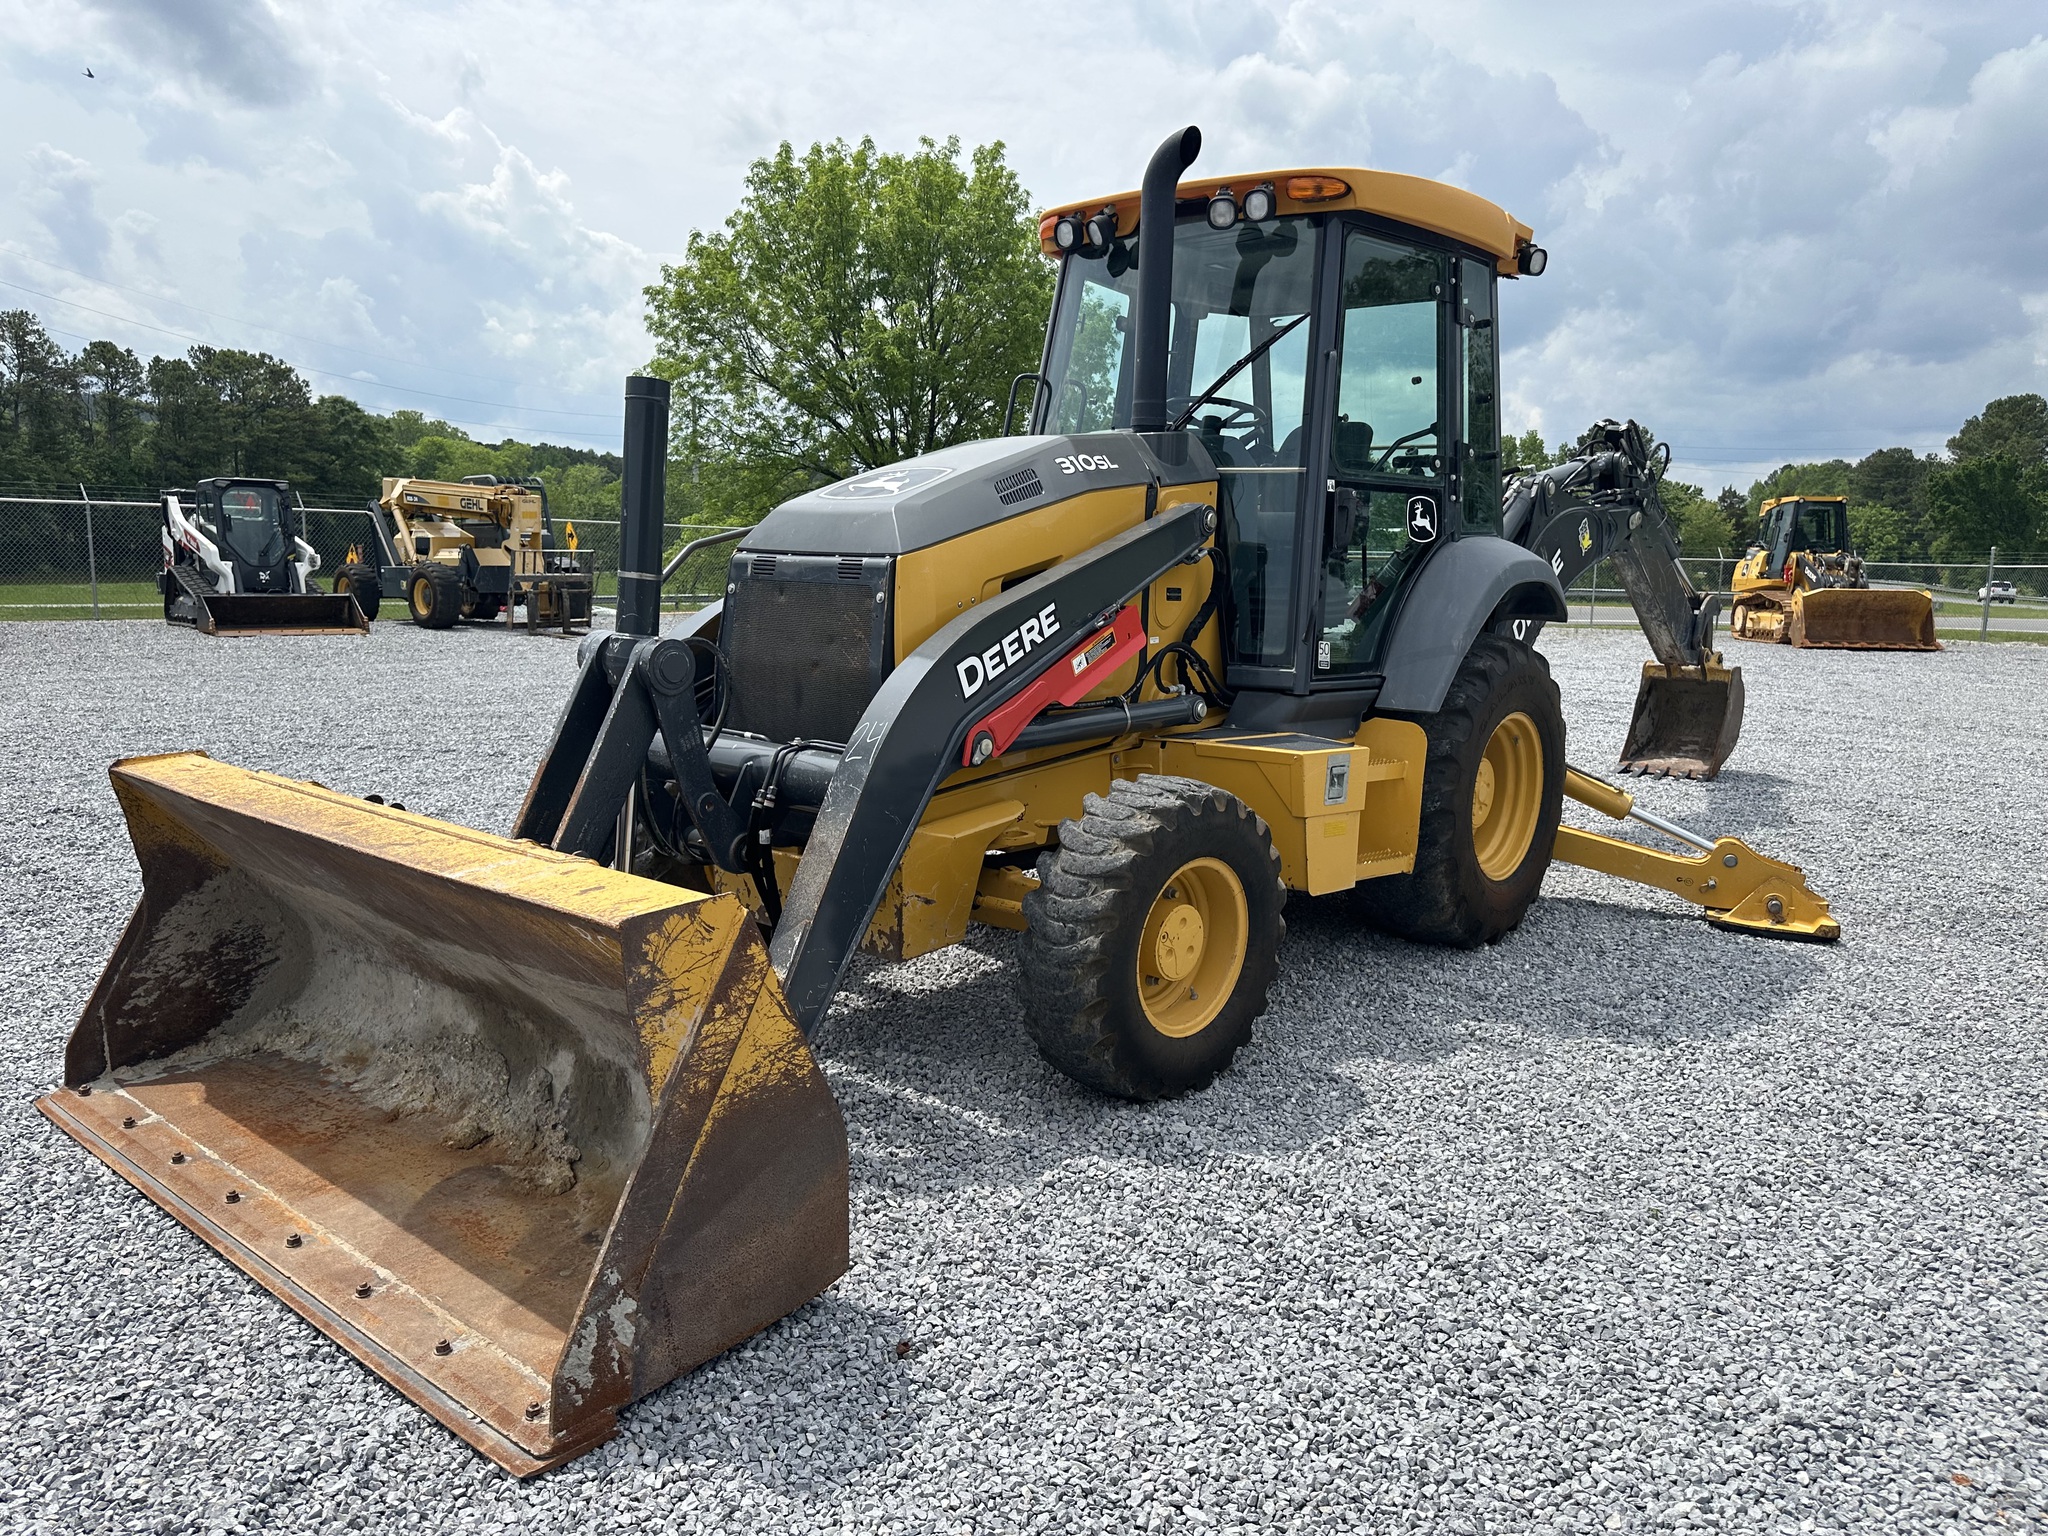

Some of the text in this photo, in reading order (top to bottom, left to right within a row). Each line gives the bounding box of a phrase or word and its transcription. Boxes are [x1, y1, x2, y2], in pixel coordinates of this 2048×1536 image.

[1054, 454, 1119, 475] 310SL
[460, 498, 484, 511] GEHL
[956, 602, 1060, 699] DEERE
[1319, 642, 1330, 656] 50
[845, 721, 889, 765] 24
